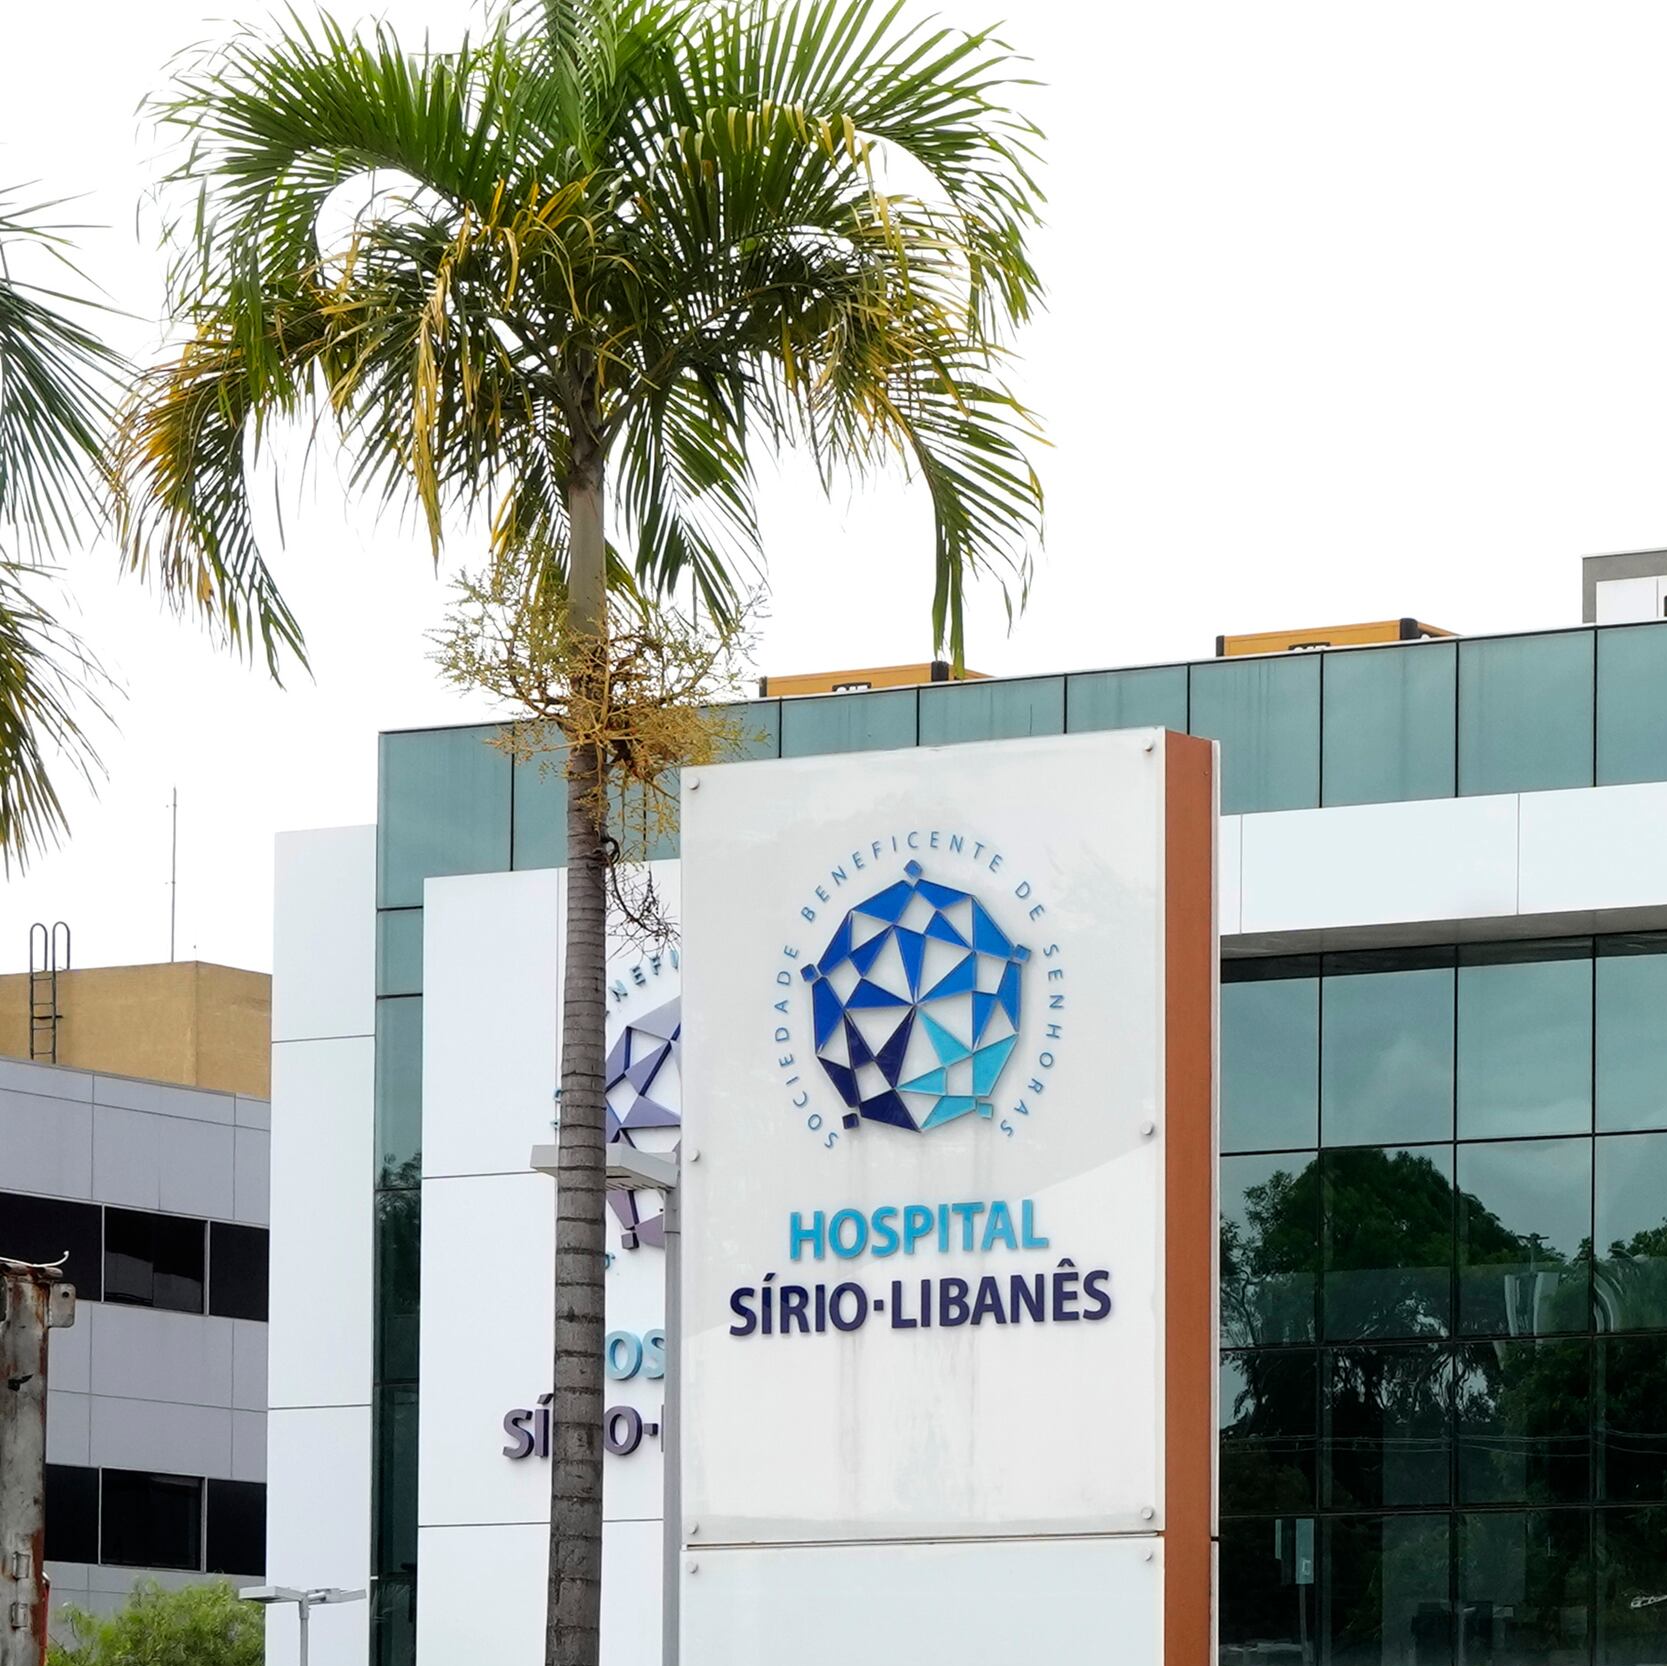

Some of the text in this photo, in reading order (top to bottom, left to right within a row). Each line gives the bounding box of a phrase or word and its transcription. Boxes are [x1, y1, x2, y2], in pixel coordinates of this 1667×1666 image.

[774, 831, 1064, 1149] SOCIEDADE BENEFICENTE DE SENHORAS
[790, 1199, 1049, 1260] HOSPITAL
